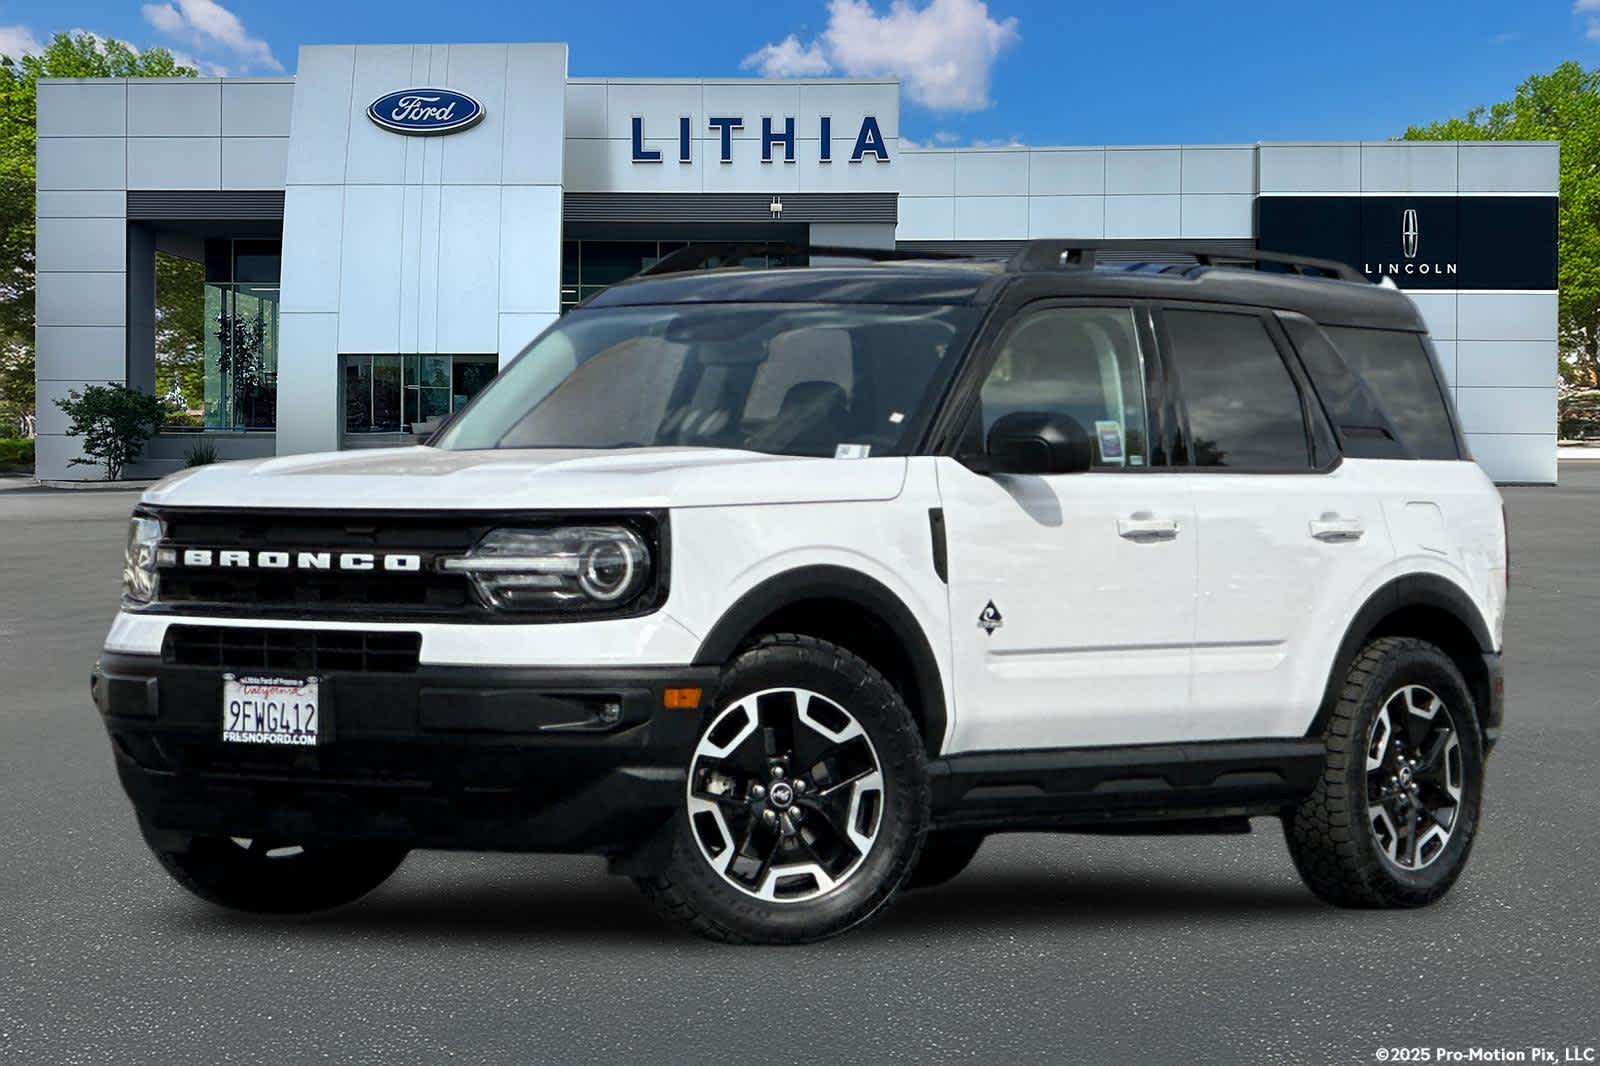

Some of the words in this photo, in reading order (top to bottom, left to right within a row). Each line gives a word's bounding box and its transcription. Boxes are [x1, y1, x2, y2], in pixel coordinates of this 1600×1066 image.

[391, 96, 456, 121] Ford
[631, 117, 890, 163] LITHIA
[1365, 263, 1457, 274] LINCOLN
[184, 550, 420, 571] BRONCO
[230, 700, 316, 734] 9FWG412
[223, 732, 317, 745] FRESNOFORD.COM
